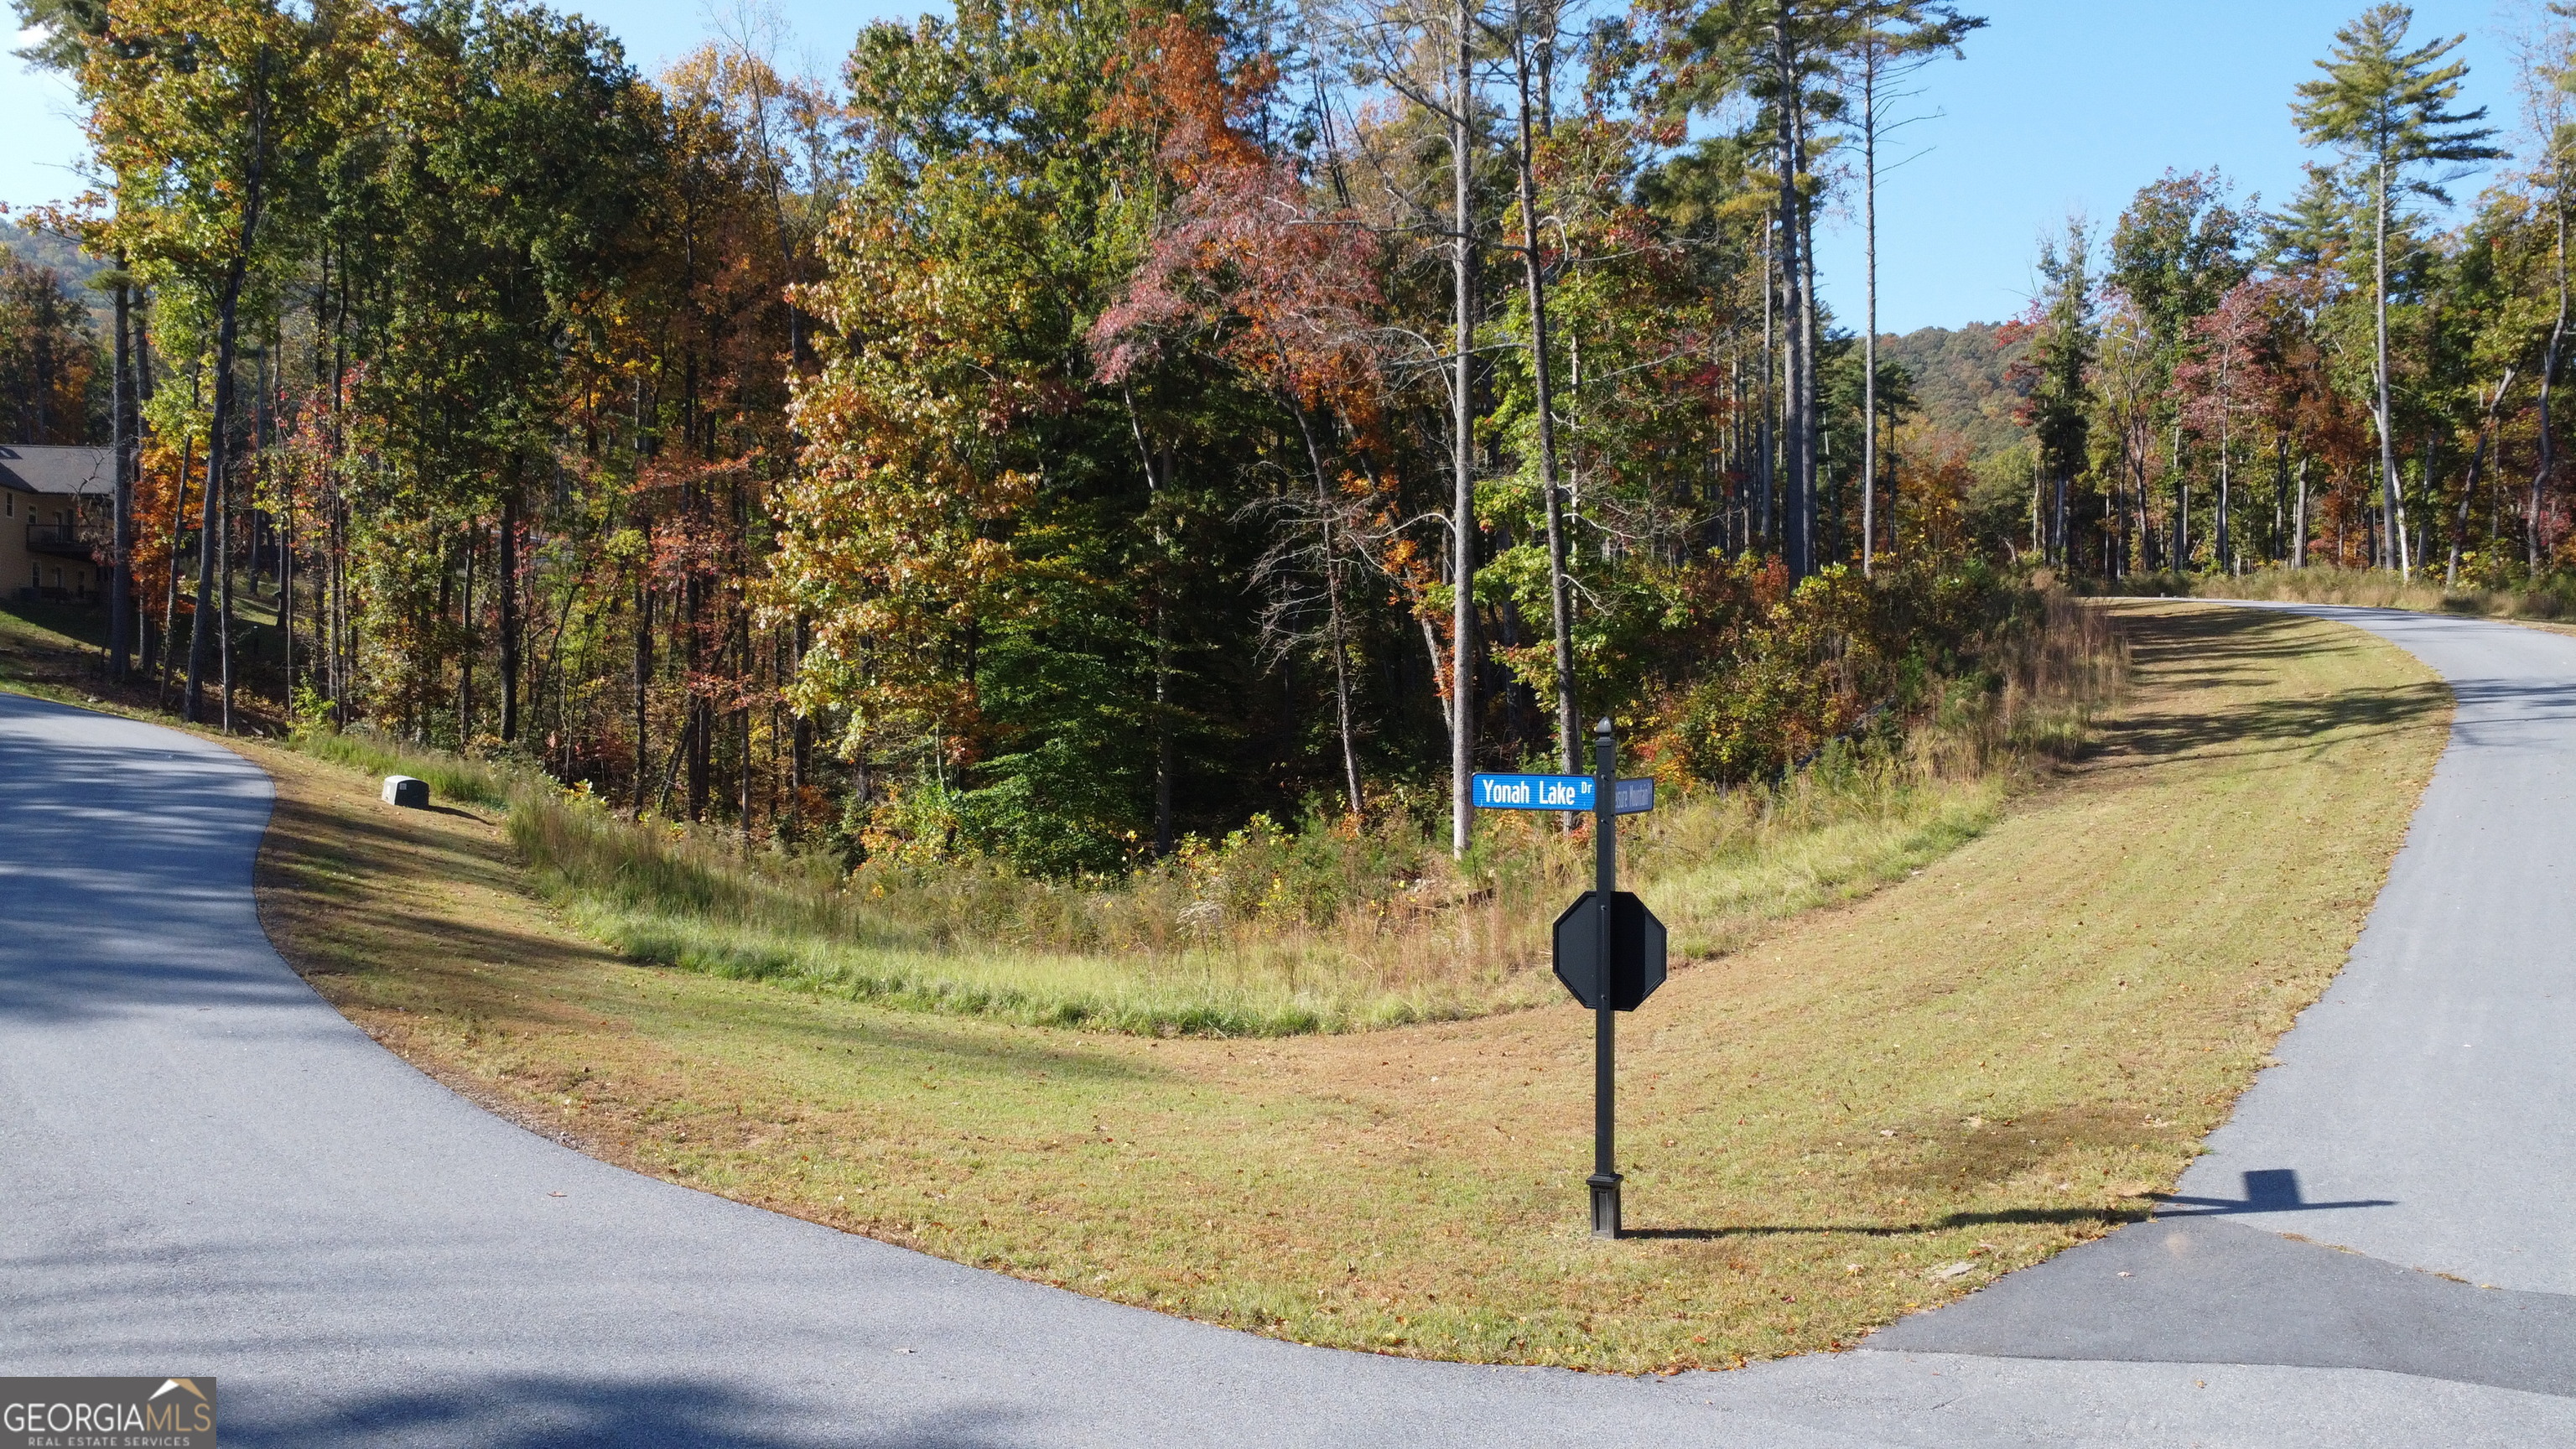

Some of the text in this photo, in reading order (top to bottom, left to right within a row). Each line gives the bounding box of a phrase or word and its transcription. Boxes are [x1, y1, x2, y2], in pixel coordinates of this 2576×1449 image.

[1483, 779, 1592, 806] Yonah Lake Dr
